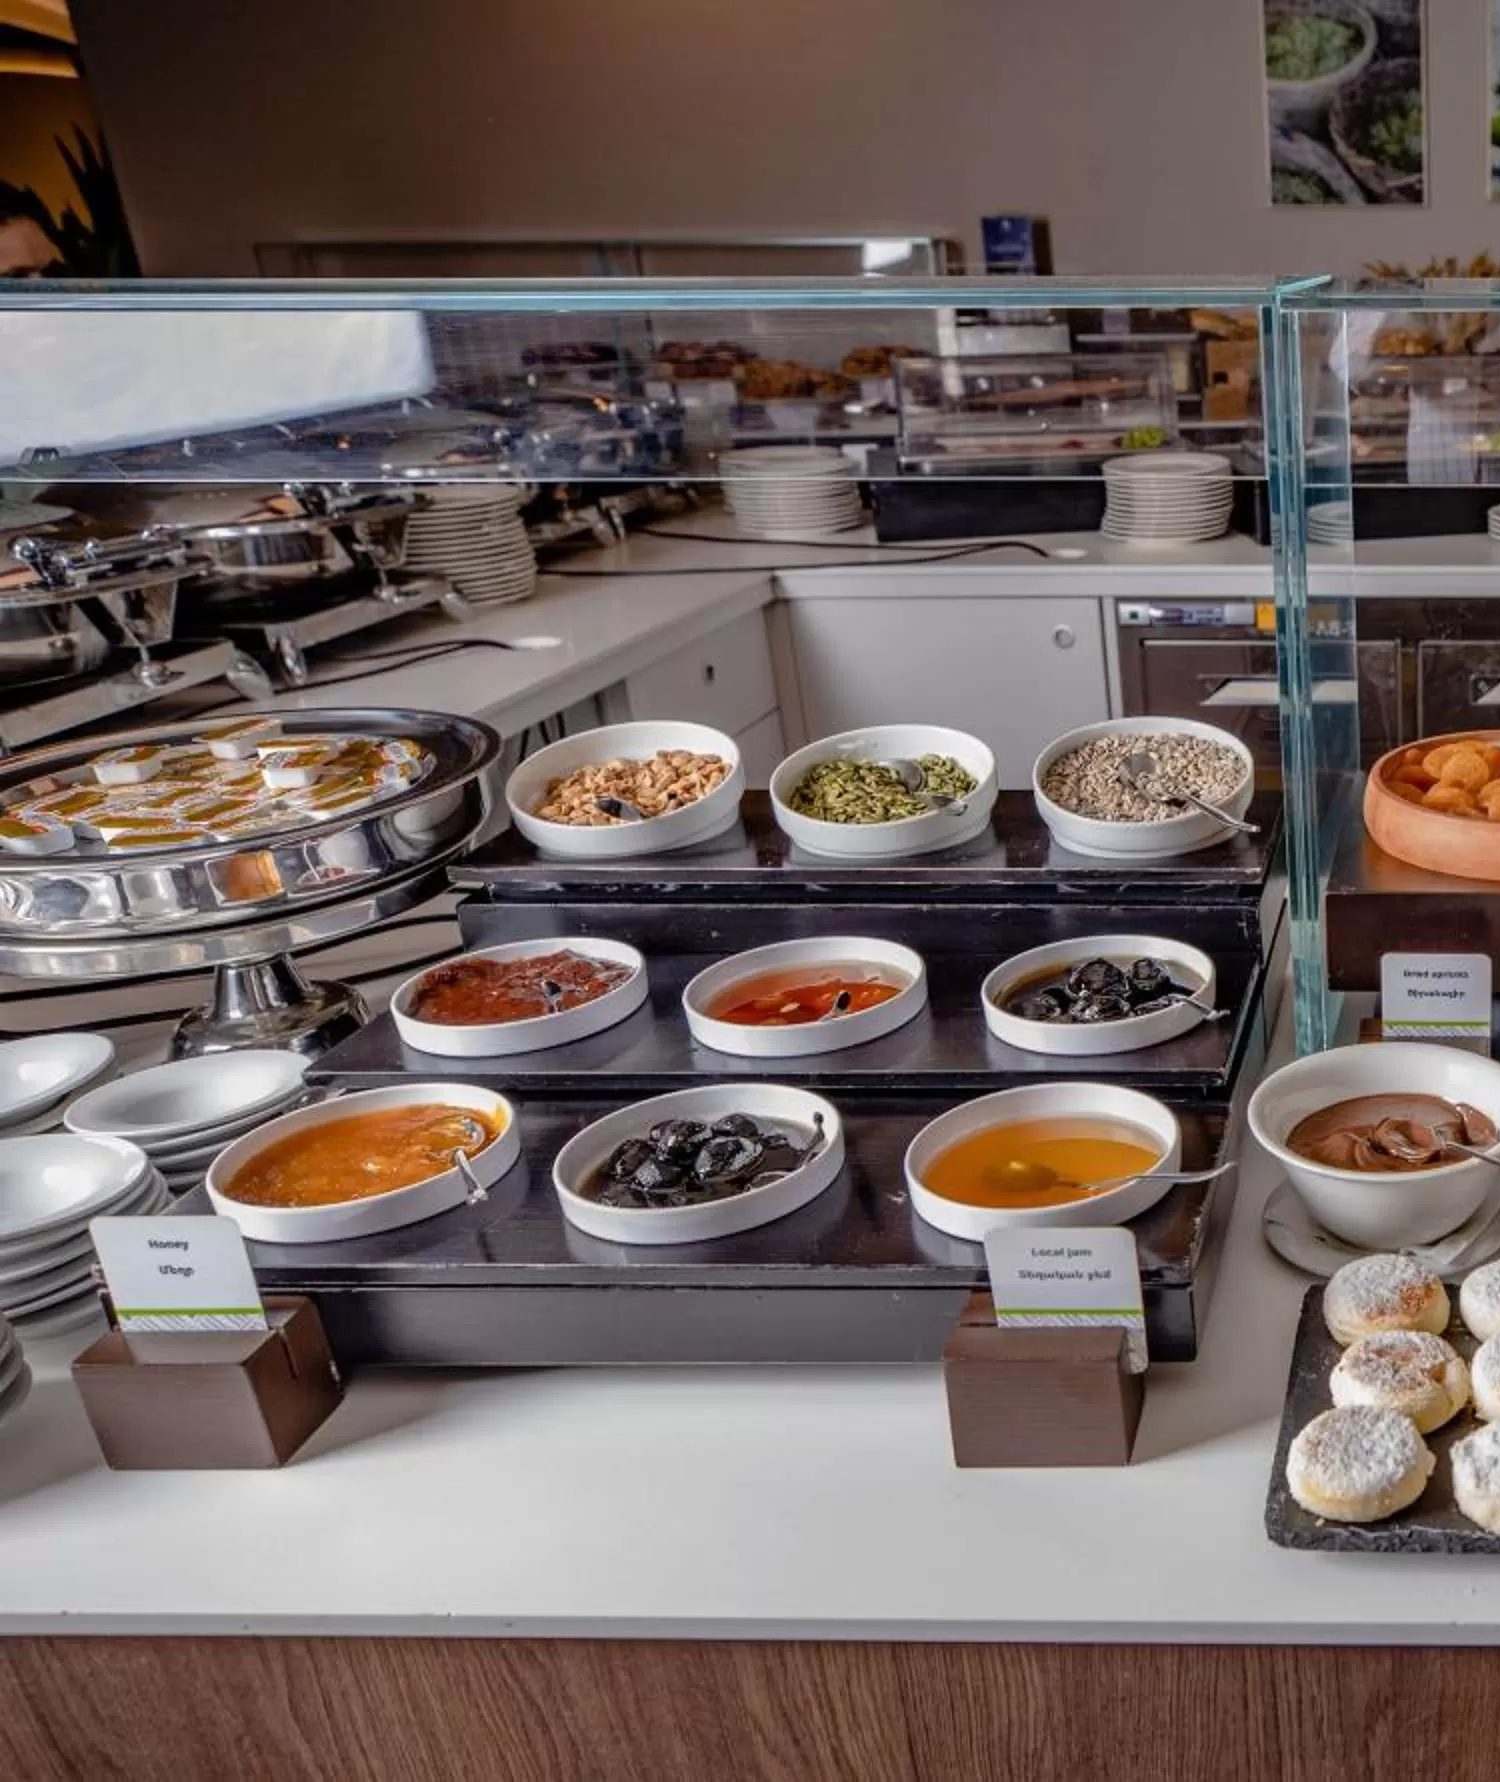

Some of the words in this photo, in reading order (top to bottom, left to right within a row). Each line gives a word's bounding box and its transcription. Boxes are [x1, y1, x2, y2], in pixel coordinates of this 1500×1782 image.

[147, 1239, 189, 1252] Honey
[1031, 1247, 1065, 1257] Local
[1066, 1247, 1093, 1259] jam
